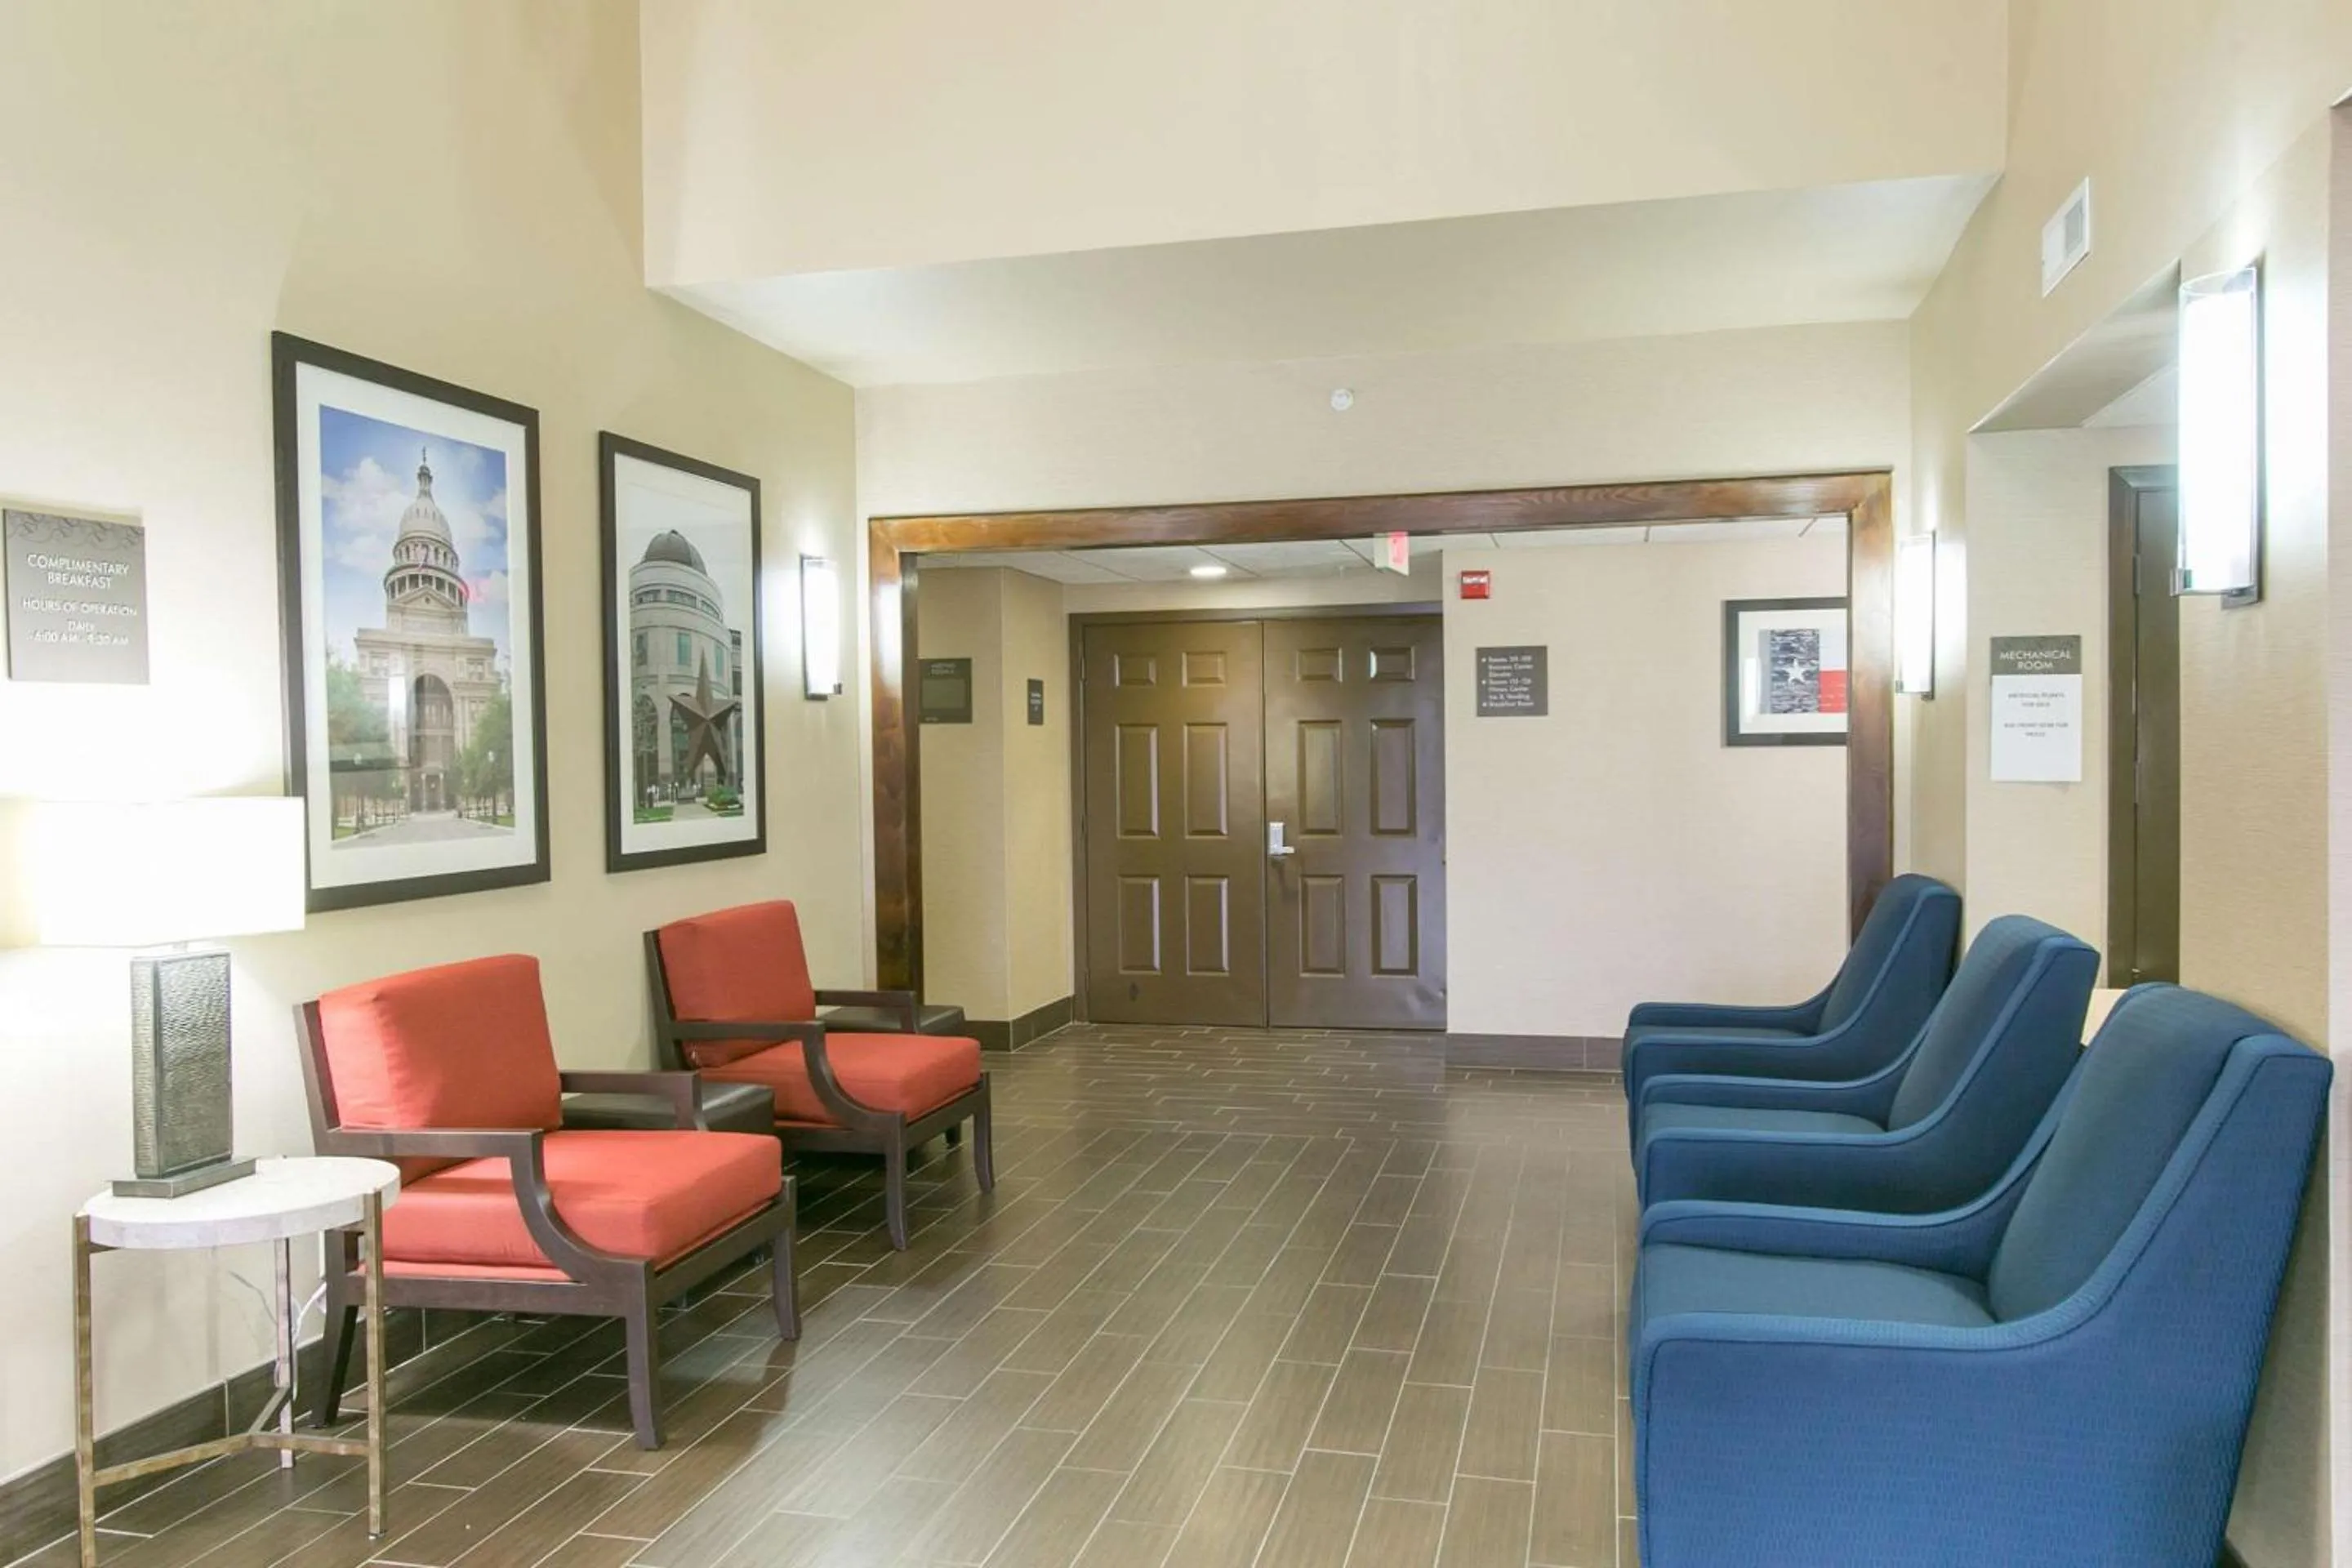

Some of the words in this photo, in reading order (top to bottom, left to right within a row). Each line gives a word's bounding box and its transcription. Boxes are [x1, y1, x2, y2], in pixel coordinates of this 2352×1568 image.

[28, 555, 129, 577] COMPLIMENTARY
[47, 572, 113, 590] BREAKFAST
[23, 598, 61, 612] HOURS
[63, 601, 77, 612] OF
[80, 602, 137, 617] OPERATION
[60, 633, 79, 644] AM
[112, 635, 129, 645] AM
[2000, 650, 2071, 660] MECHANICAL
[2017, 661, 2053, 670] ROOM
